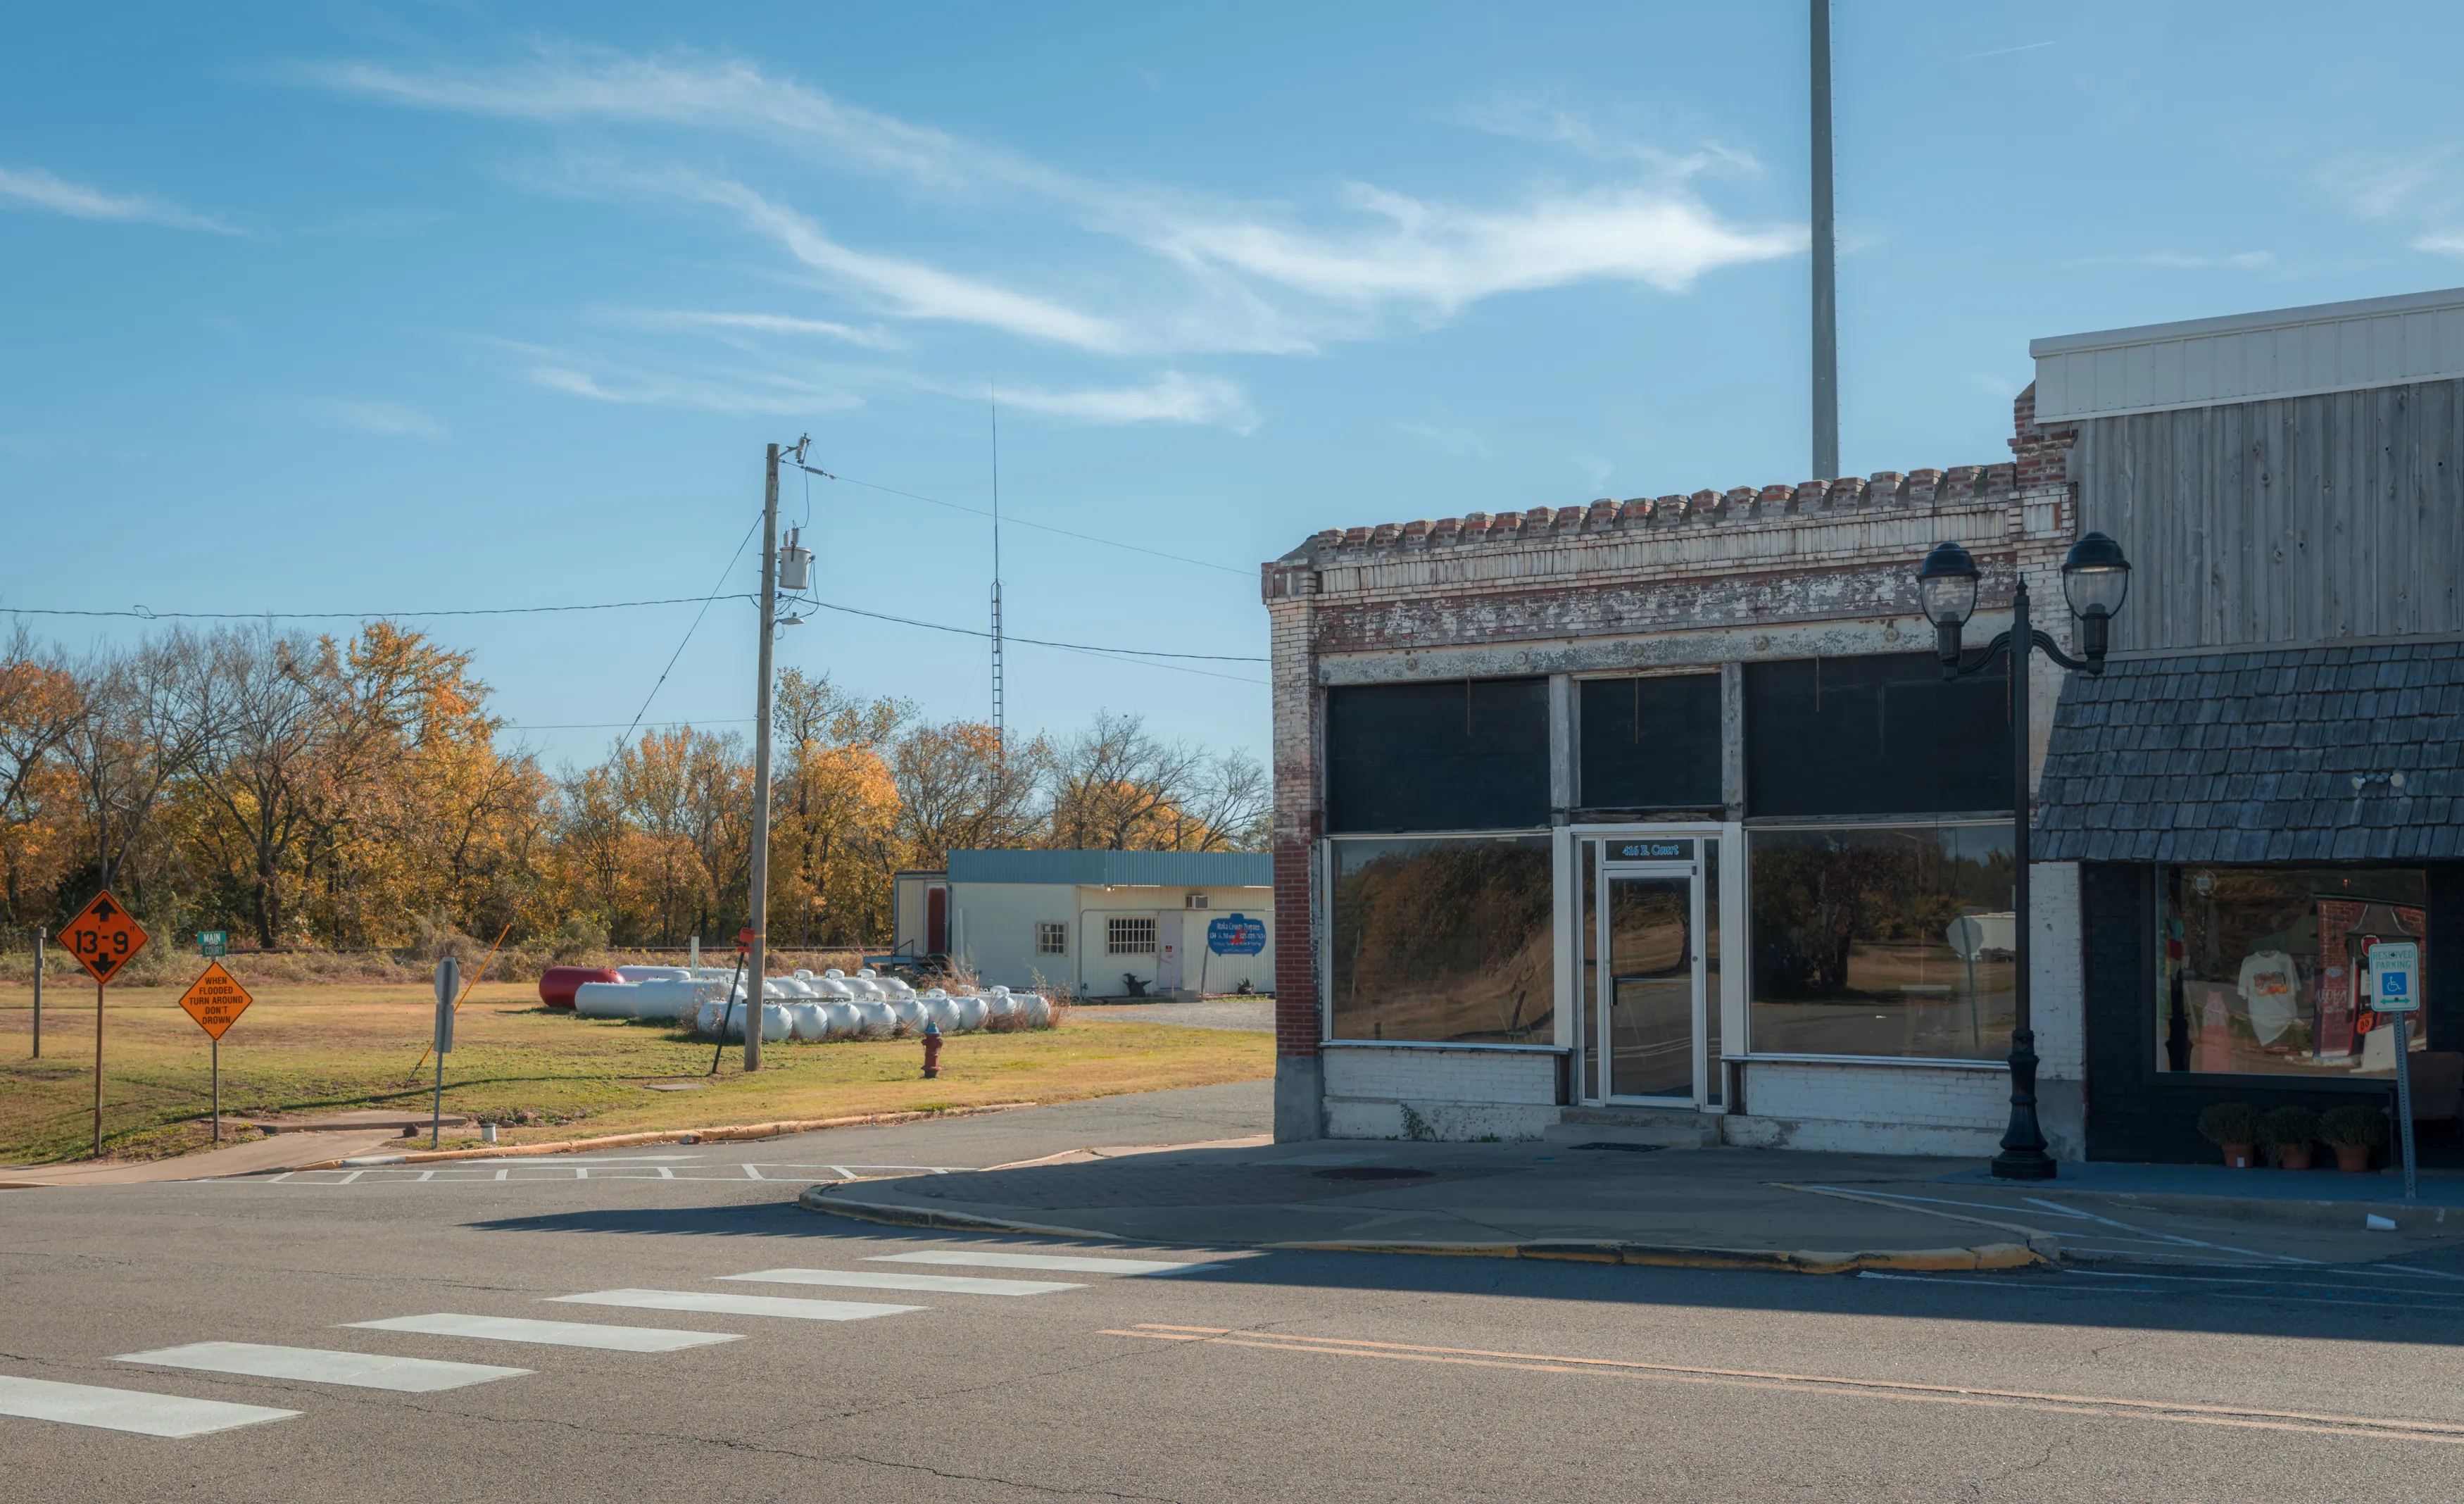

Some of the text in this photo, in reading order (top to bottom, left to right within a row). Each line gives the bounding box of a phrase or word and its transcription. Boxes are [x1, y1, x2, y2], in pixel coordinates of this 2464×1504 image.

[1622, 844, 1680, 856] 416 E. Court
[1243, 922, 1260, 932] Propane
[203, 933, 220, 943] MAIN
[205, 946, 223, 955] COURT
[2372, 950, 2413, 960] RESERVED
[2375, 960, 2412, 970] PARKING
[205, 977, 227, 985] WHEN
[199, 986, 233, 995] FLOODED
[189, 996, 243, 1005] TURN AROUND
[205, 1005, 228, 1015] DON'T
[202, 1016, 231, 1024] DROWN
